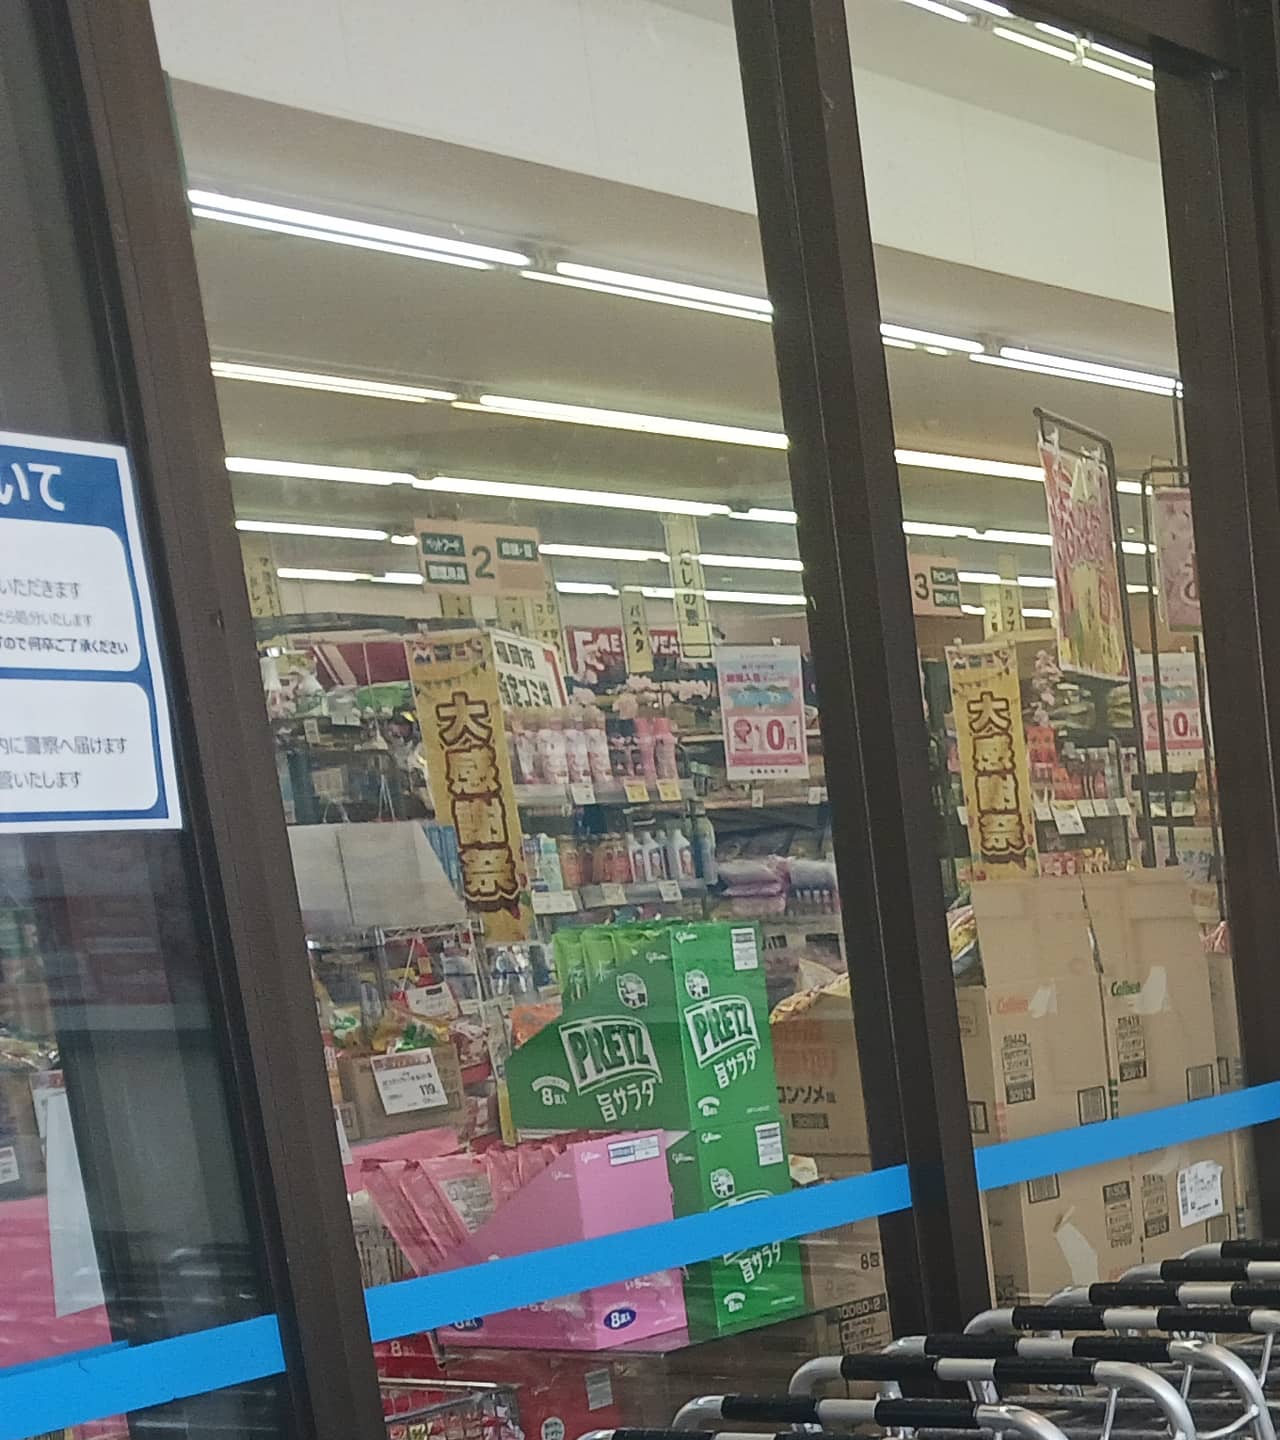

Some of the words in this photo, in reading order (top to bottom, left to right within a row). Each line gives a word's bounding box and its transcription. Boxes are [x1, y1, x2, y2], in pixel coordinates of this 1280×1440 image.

[472, 545, 495, 579] 2
[914, 573, 929, 600] 3
[692, 1003, 752, 1056] PRETZ
[567, 1024, 651, 1082] PRETZ
[596, 1078, 657, 1123] 旨サラダ
